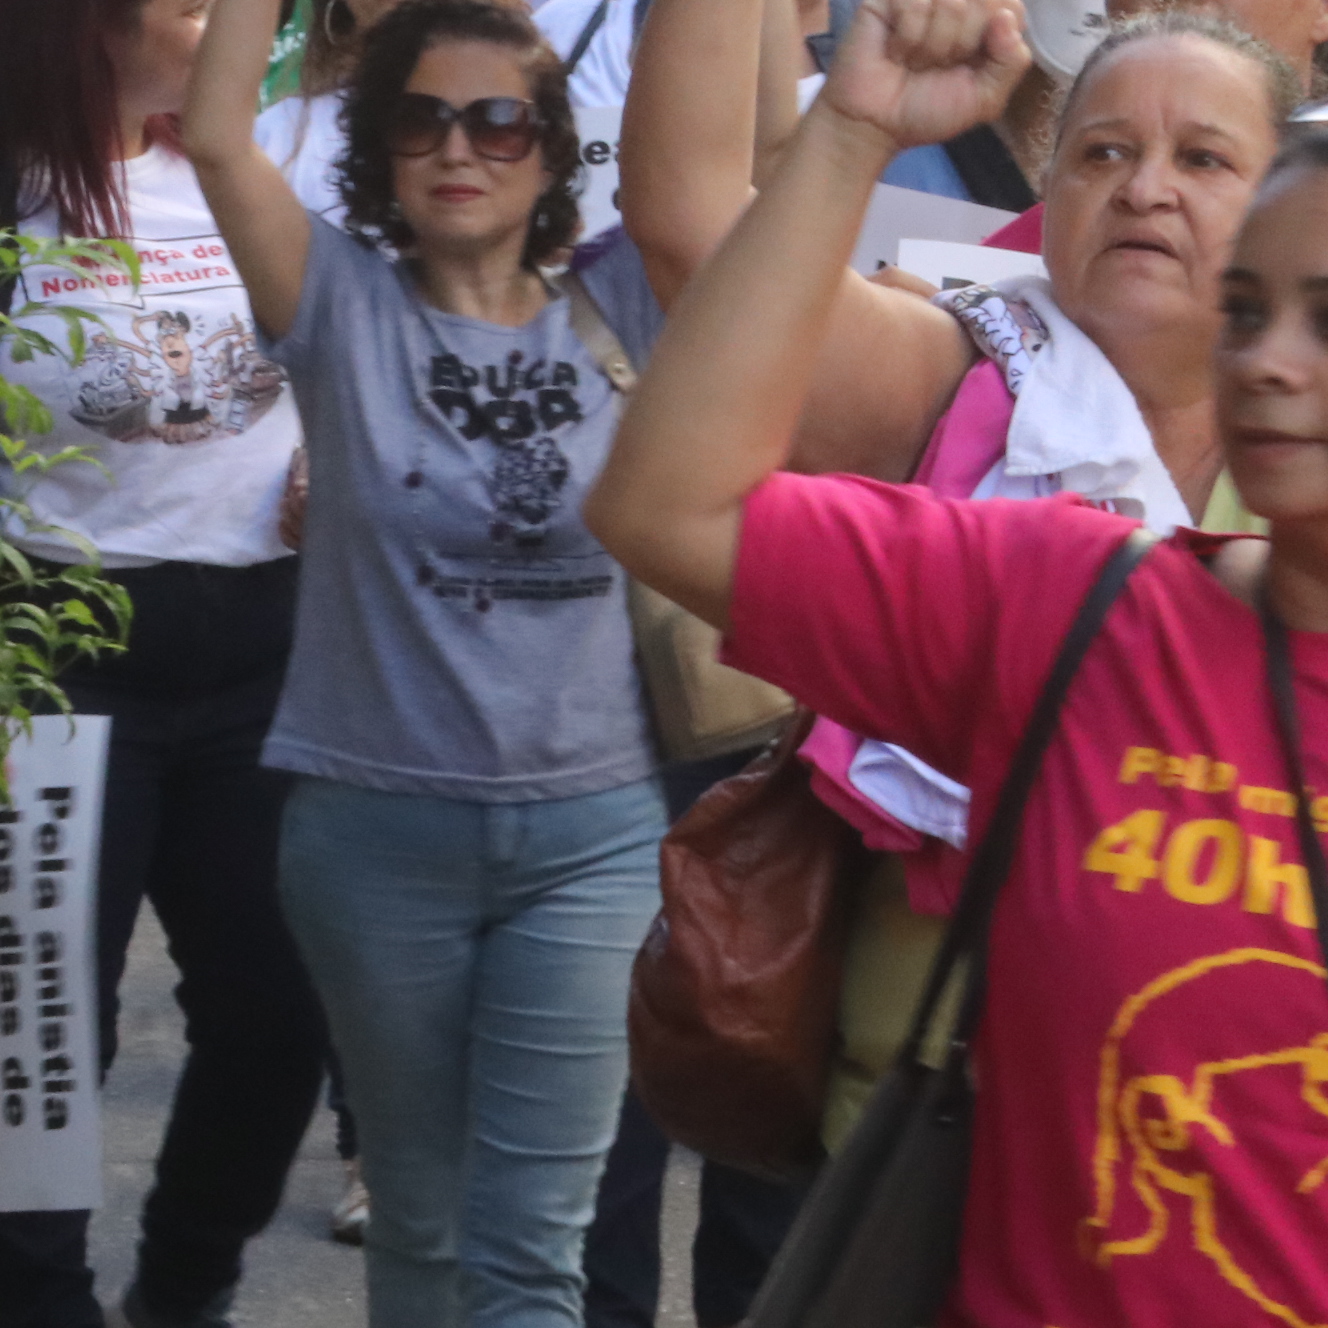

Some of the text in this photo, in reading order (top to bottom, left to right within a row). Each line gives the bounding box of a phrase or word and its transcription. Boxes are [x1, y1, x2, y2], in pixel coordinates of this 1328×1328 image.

[192, 243, 225, 259] de
[1118, 745, 1239, 793] Pela
[1083, 809, 1319, 929] 40h
[33, 786, 76, 1131] Pela anistia
[2, 1057, 31, 1128] de
